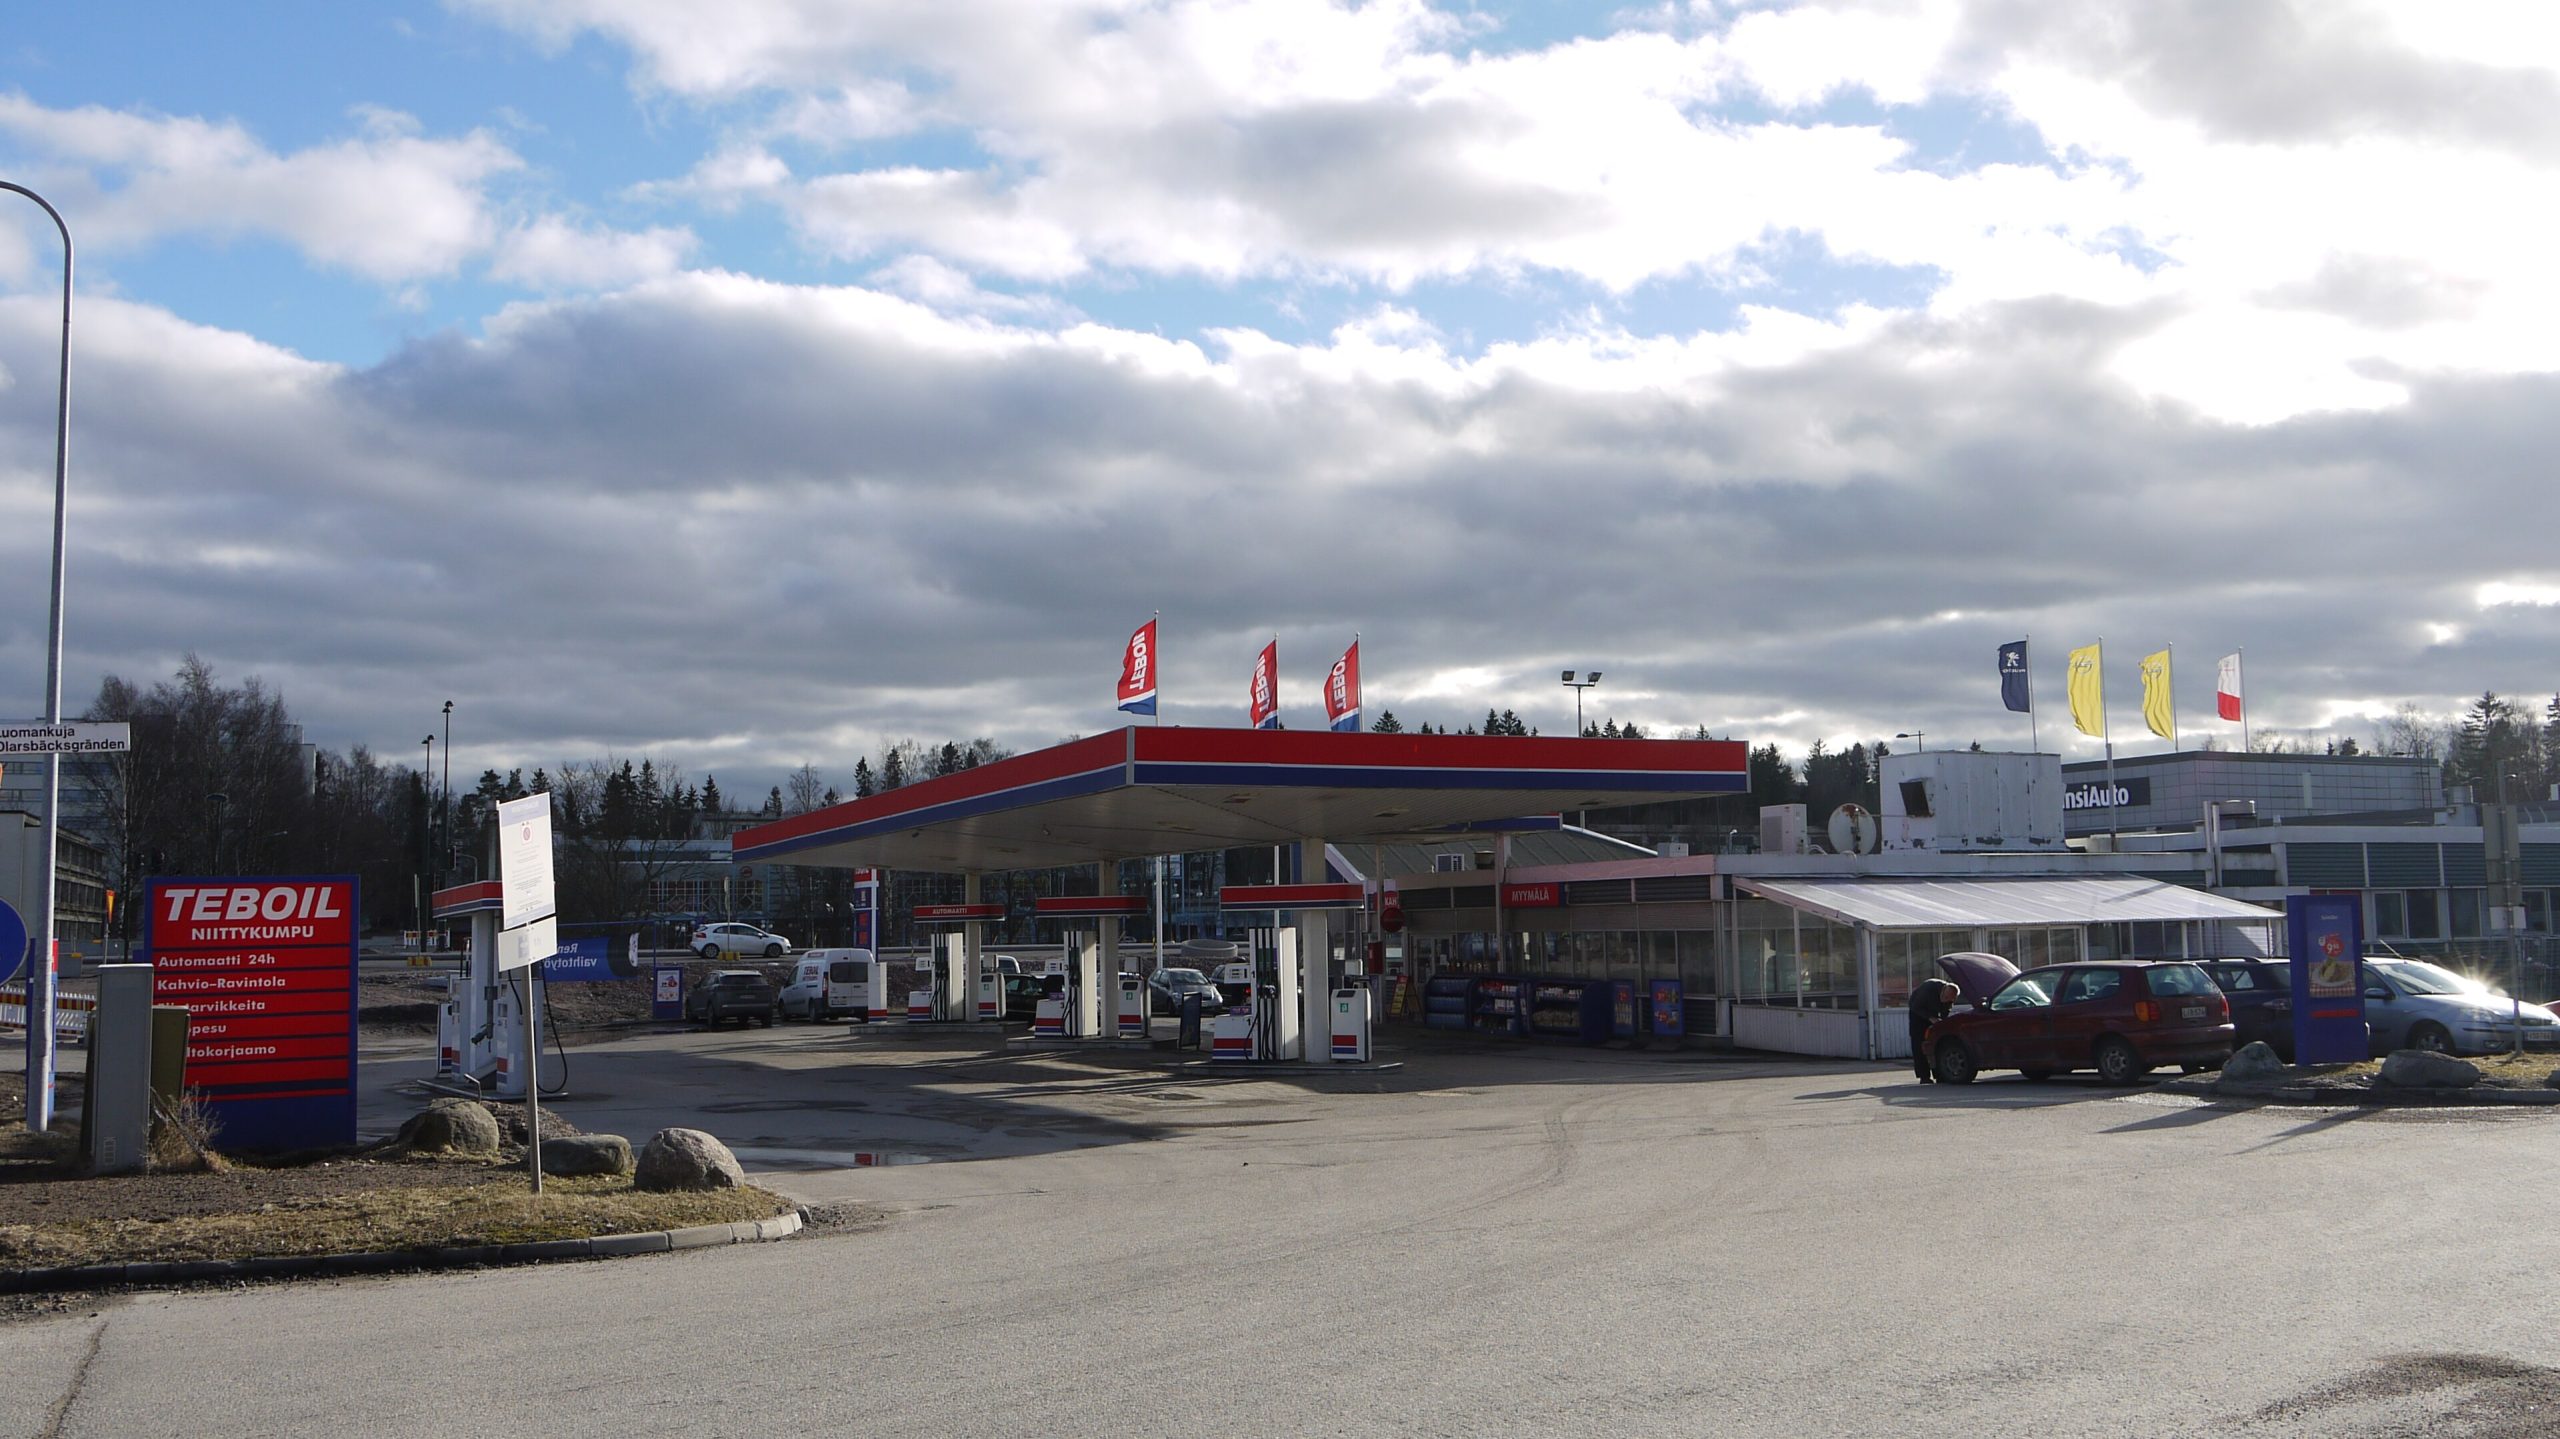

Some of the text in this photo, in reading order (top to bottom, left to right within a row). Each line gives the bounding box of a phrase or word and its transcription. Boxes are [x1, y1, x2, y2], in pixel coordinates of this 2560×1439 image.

[2062, 784, 2129, 809] nsiAuto
[1512, 888, 1550, 902] MYYMÄLÄ
[164, 886, 341, 922] TEBOIL
[191, 926, 314, 941] NIITTYKUMPU
[158, 953, 276, 967] Automaatti 24h
[157, 976, 286, 990] Kahvio-Ravintola
[187, 1024, 227, 1036] pesu
[186, 1045, 276, 1058] ltokorjaamo
